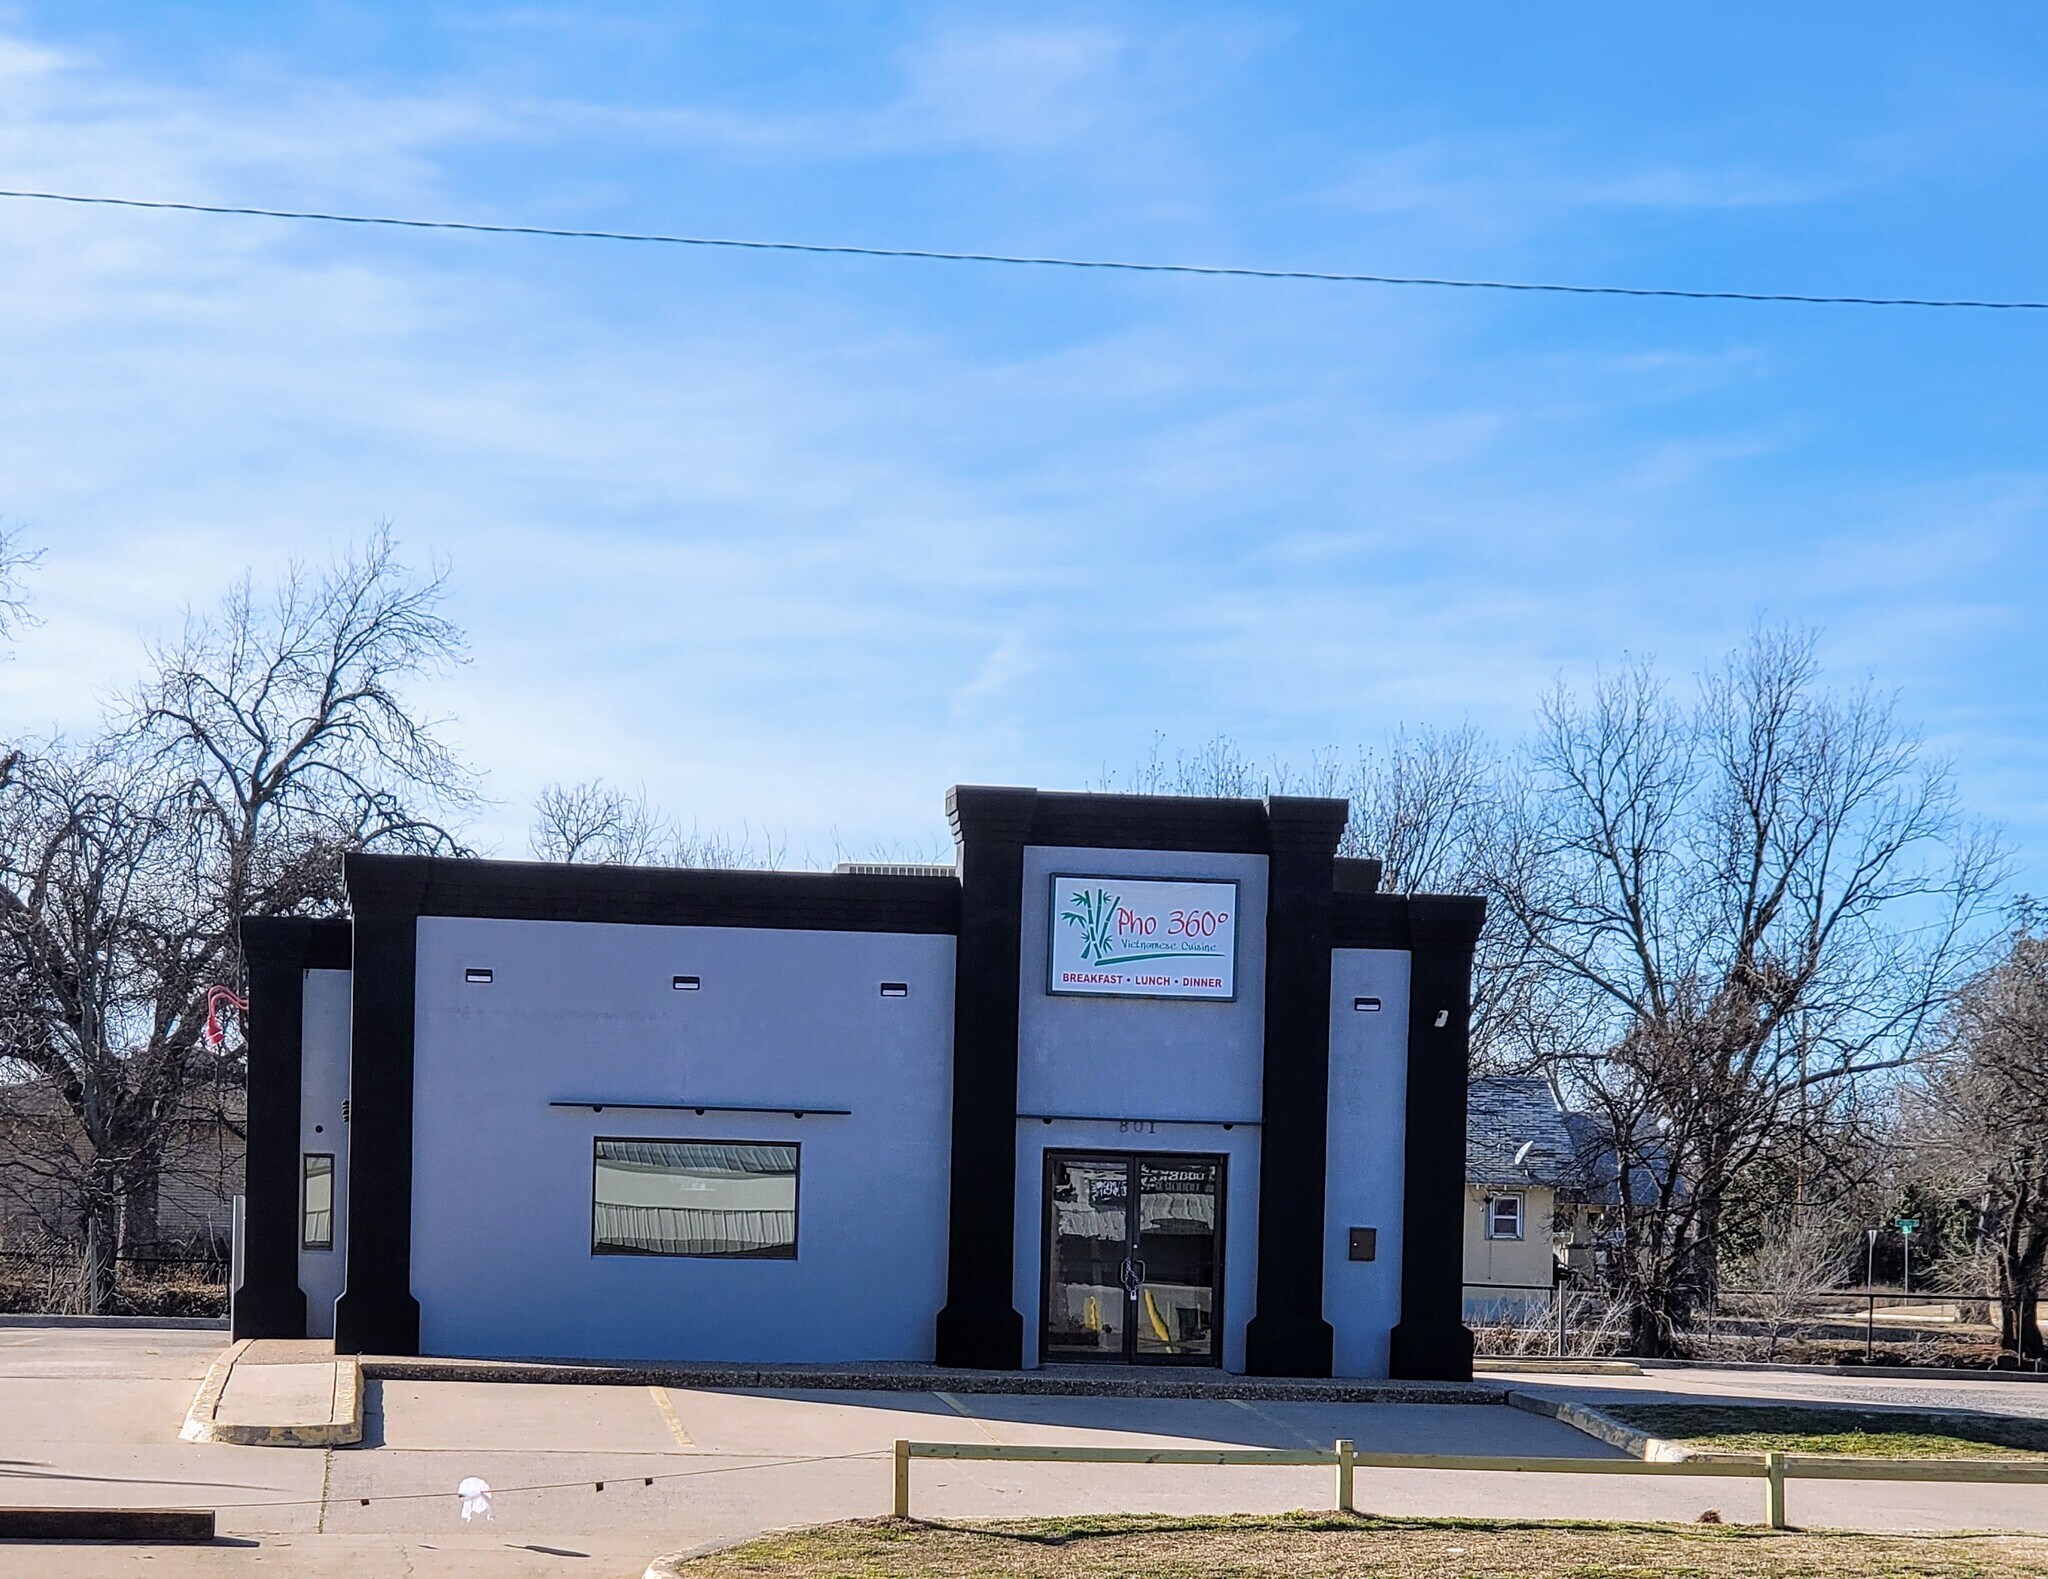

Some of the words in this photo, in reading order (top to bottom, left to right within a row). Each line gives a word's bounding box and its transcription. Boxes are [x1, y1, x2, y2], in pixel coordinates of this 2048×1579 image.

[1117, 907, 1157, 936] Pho
[1121, 938, 1178, 951] Vietnamese
[1181, 941, 1217, 952] Cuisine
[1063, 972, 1123, 984] BREAKFAST
[1135, 975, 1171, 986] LUNCH
[1183, 977, 1222, 988] DINNER
[1119, 1119, 1156, 1134] 801
